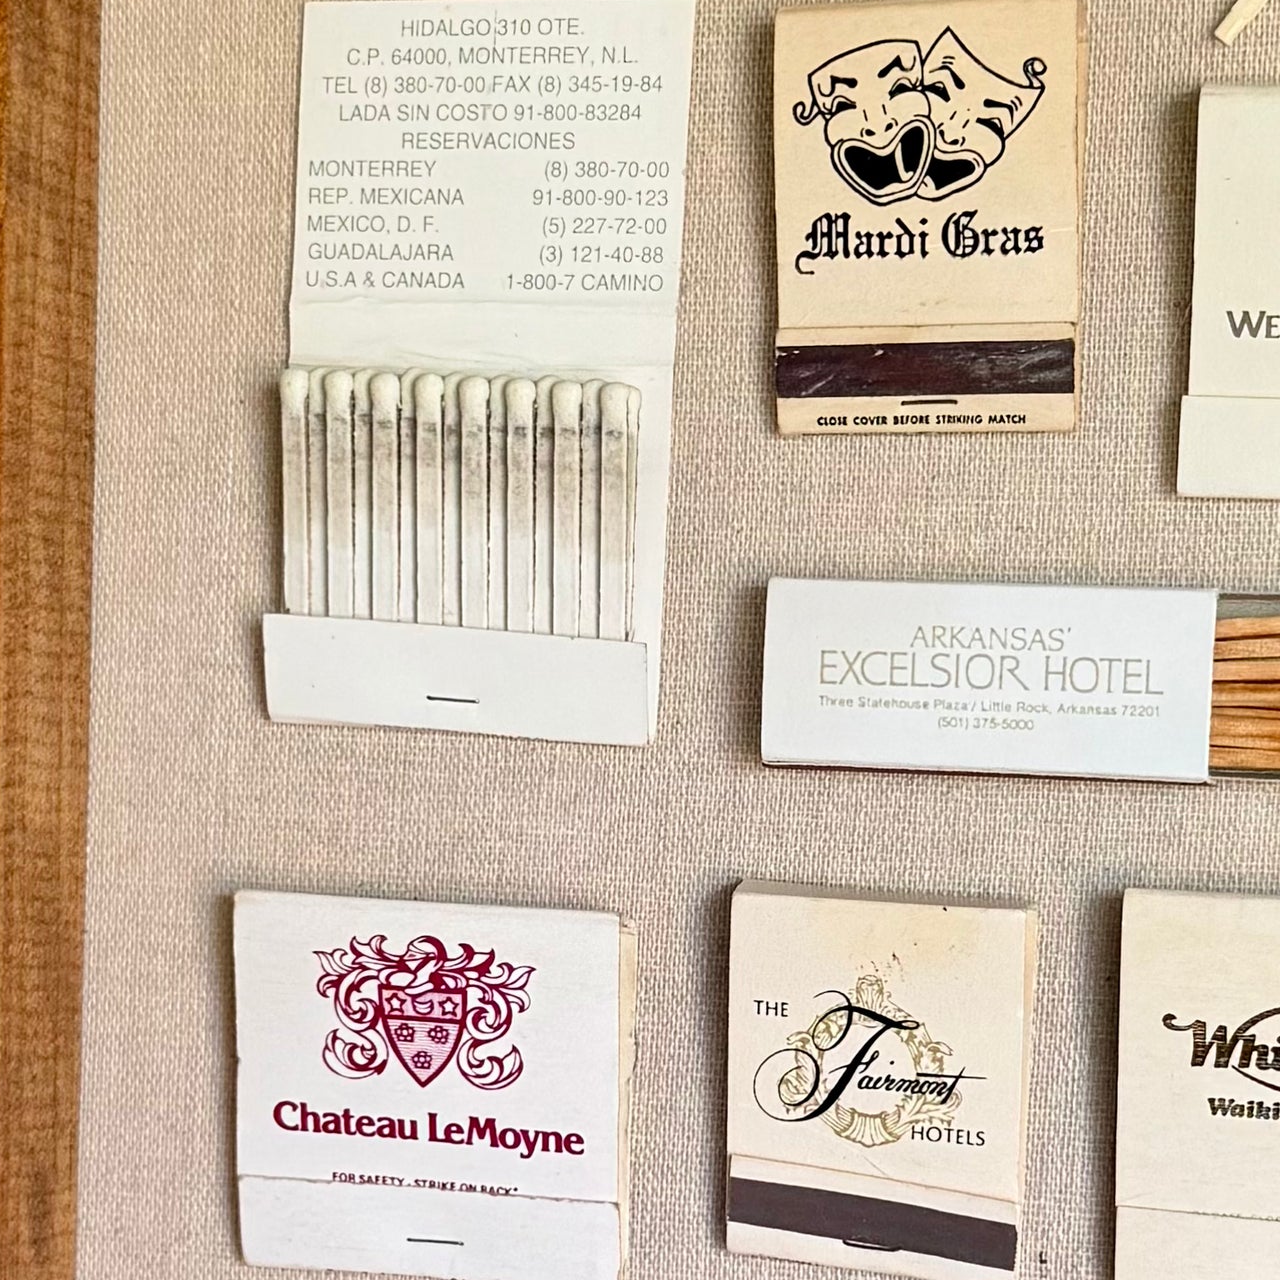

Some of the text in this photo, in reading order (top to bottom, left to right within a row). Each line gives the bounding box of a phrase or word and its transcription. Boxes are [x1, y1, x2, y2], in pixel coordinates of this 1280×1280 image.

[401, 18, 584, 36] HIDALGO 310 OTE.
[347, 46, 638, 66] C.P. 64000, MONTERREY, N.L.
[323, 76, 663, 96] TEL (8) 380-70-00 FAX (8) 345-19-84
[339, 104, 641, 121] LADA SIN COSTO 91-800-83284
[402, 133, 575, 149] RESERVACIONES
[309, 161, 669, 181] MONTERREY (8) 380-70-00
[309, 188, 668, 206] REP. MEXICANA 91-800-90-123
[307, 216, 667, 237] MEXICO, D. F. (5) 227-72-00
[795, 210, 1044, 274] Mardi Gras
[308, 244, 663, 265] GUADALAJARA (3) 121-40-88
[364, 272, 375, 288] &
[382, 271, 464, 289] CANADA
[508, 274, 574, 290] 1-800-7
[581, 275, 663, 291] CAMINO
[818, 414, 1026, 426] CLOSE COVER BEFORE STRIKING MATCH
[910, 626, 1071, 651] ARKANSAS'
[820, 651, 1163, 694] EXCELSIOR HOTEL
[819, 695, 853, 707] Three
[858, 697, 929, 711] Statehouse
[934, 699, 968, 711] Plaza
[981, 701, 1011, 713] Little
[1017, 701, 1052, 715] Rock,
[1057, 703, 1117, 715] Arkansas
[1121, 705, 1160, 716] 72201
[937, 717, 1034, 730] (501) 375-5000
[754, 1000, 788, 1017] THE
[753, 990, 986, 1121] Fairmont
[273, 1100, 584, 1158] Chateau LeMoyne
[911, 1126, 985, 1146] HOTELS
[333, 1172, 355, 1184] FOR
[359, 1174, 404, 1186] SAFETY
[415, 1179, 455, 1191] STRIKE
